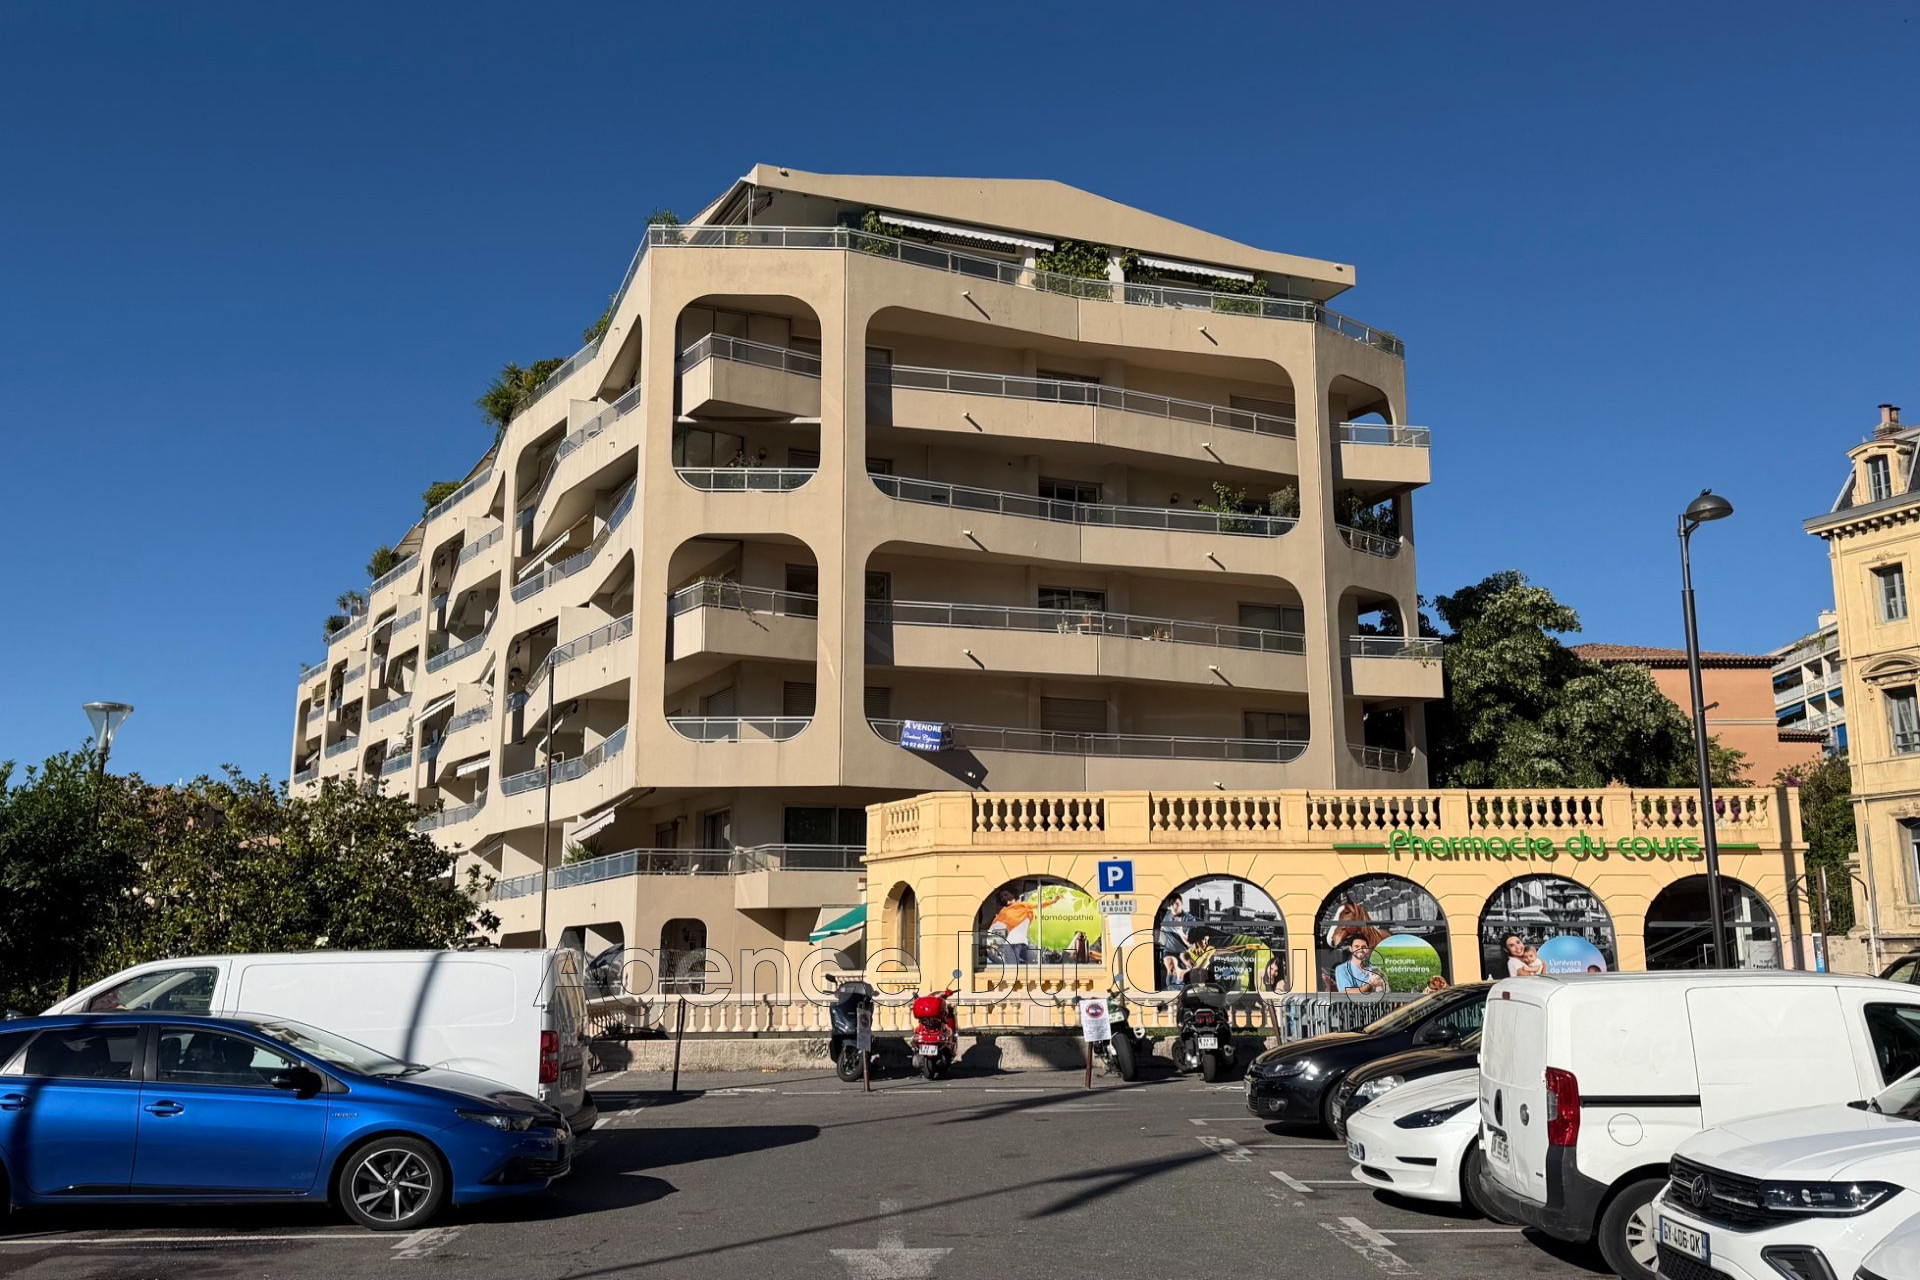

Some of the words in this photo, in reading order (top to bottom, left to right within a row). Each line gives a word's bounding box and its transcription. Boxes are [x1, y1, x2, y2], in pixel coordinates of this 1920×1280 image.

[912, 723, 942, 733] VENDRE
[1389, 829, 1554, 855] Pharmacie
[1566, 830, 1606, 855] du
[1617, 835, 1701, 855] cours
[1107, 866, 1124, 887] P
